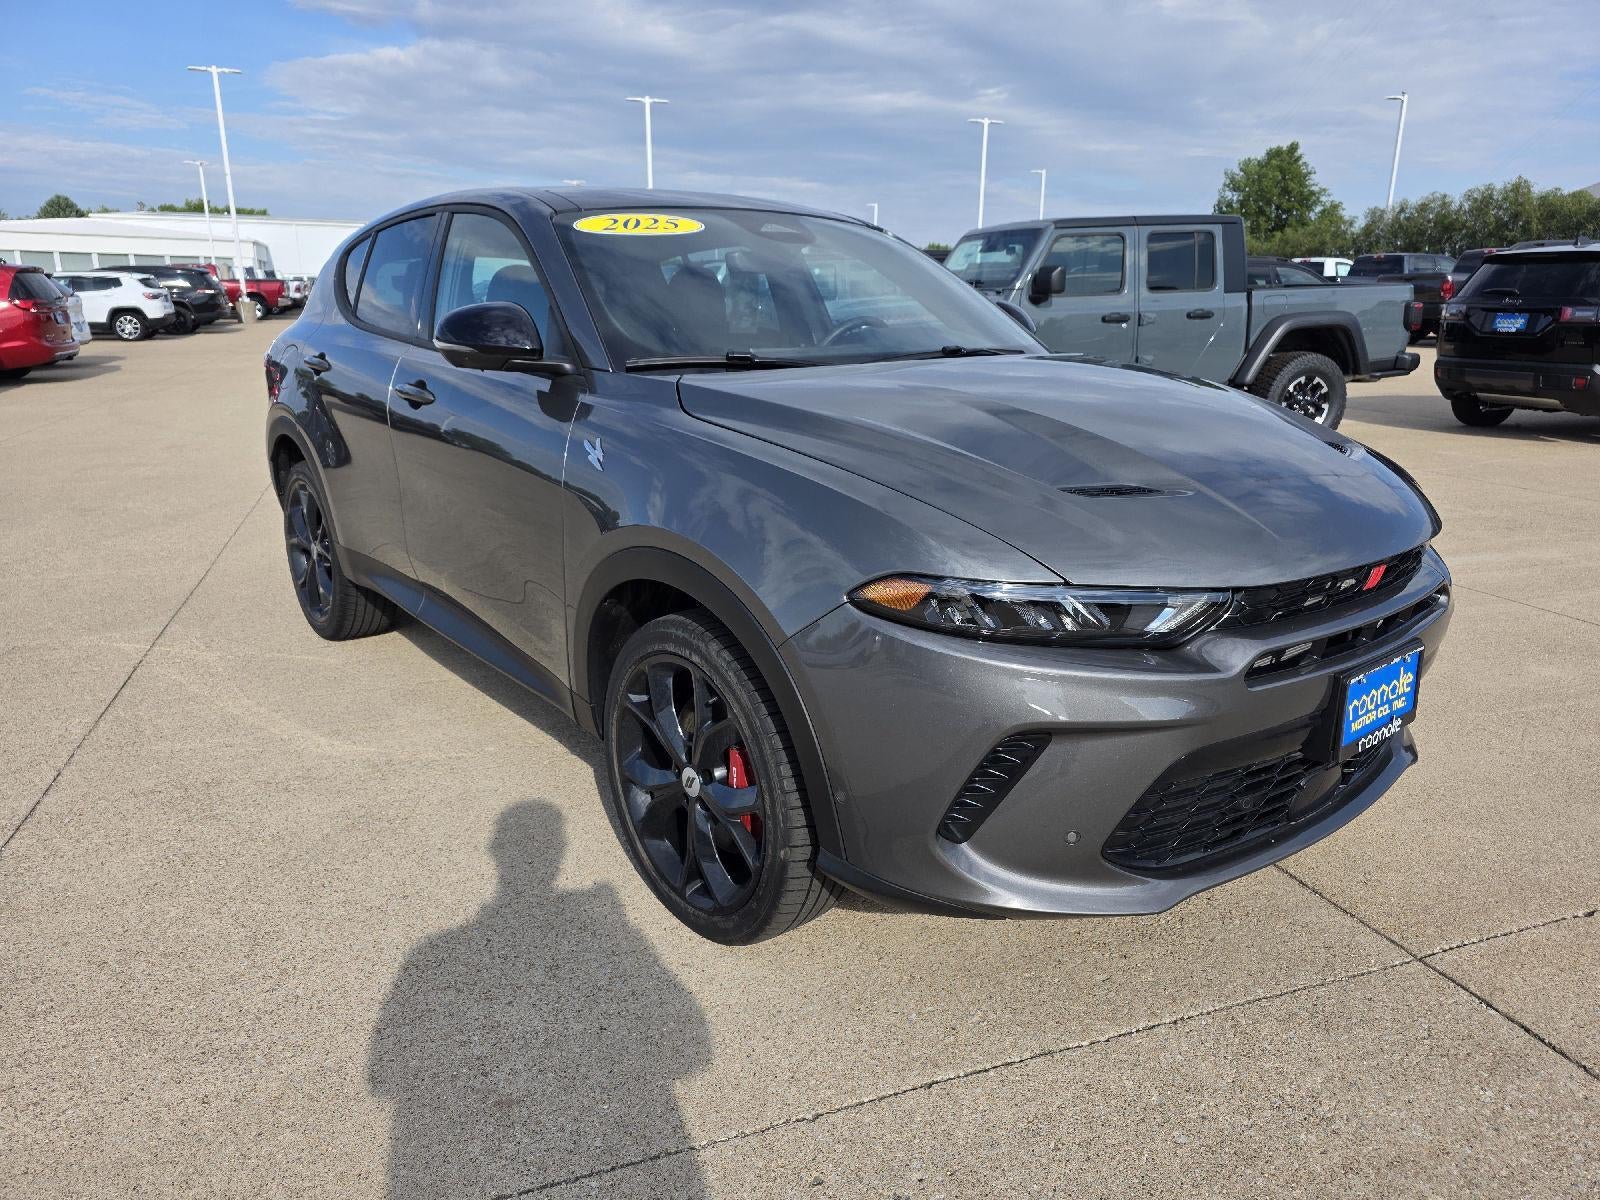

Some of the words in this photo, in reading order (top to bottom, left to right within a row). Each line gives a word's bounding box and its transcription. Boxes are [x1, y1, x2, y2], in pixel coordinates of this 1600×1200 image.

[603, 217, 679, 231] 2025
[1348, 666, 1414, 721] roanoke
[1351, 711, 1377, 733] MOTOR
